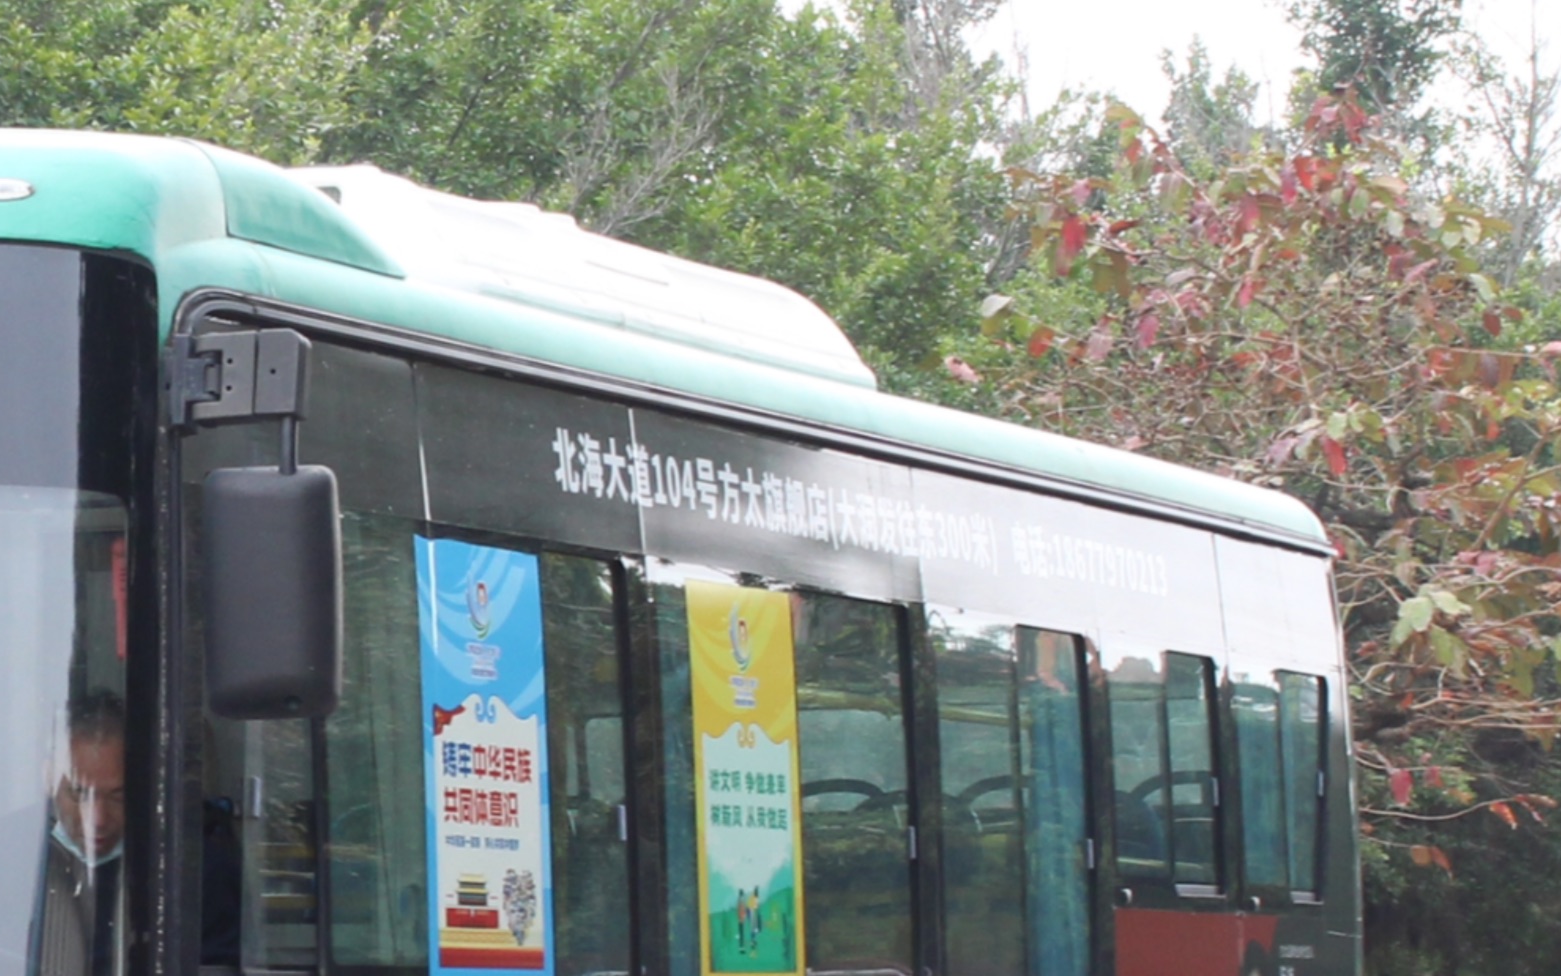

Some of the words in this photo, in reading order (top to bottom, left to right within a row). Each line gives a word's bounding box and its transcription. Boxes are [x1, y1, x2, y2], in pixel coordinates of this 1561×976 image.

[443, 787, 519, 828] 共同体意识
